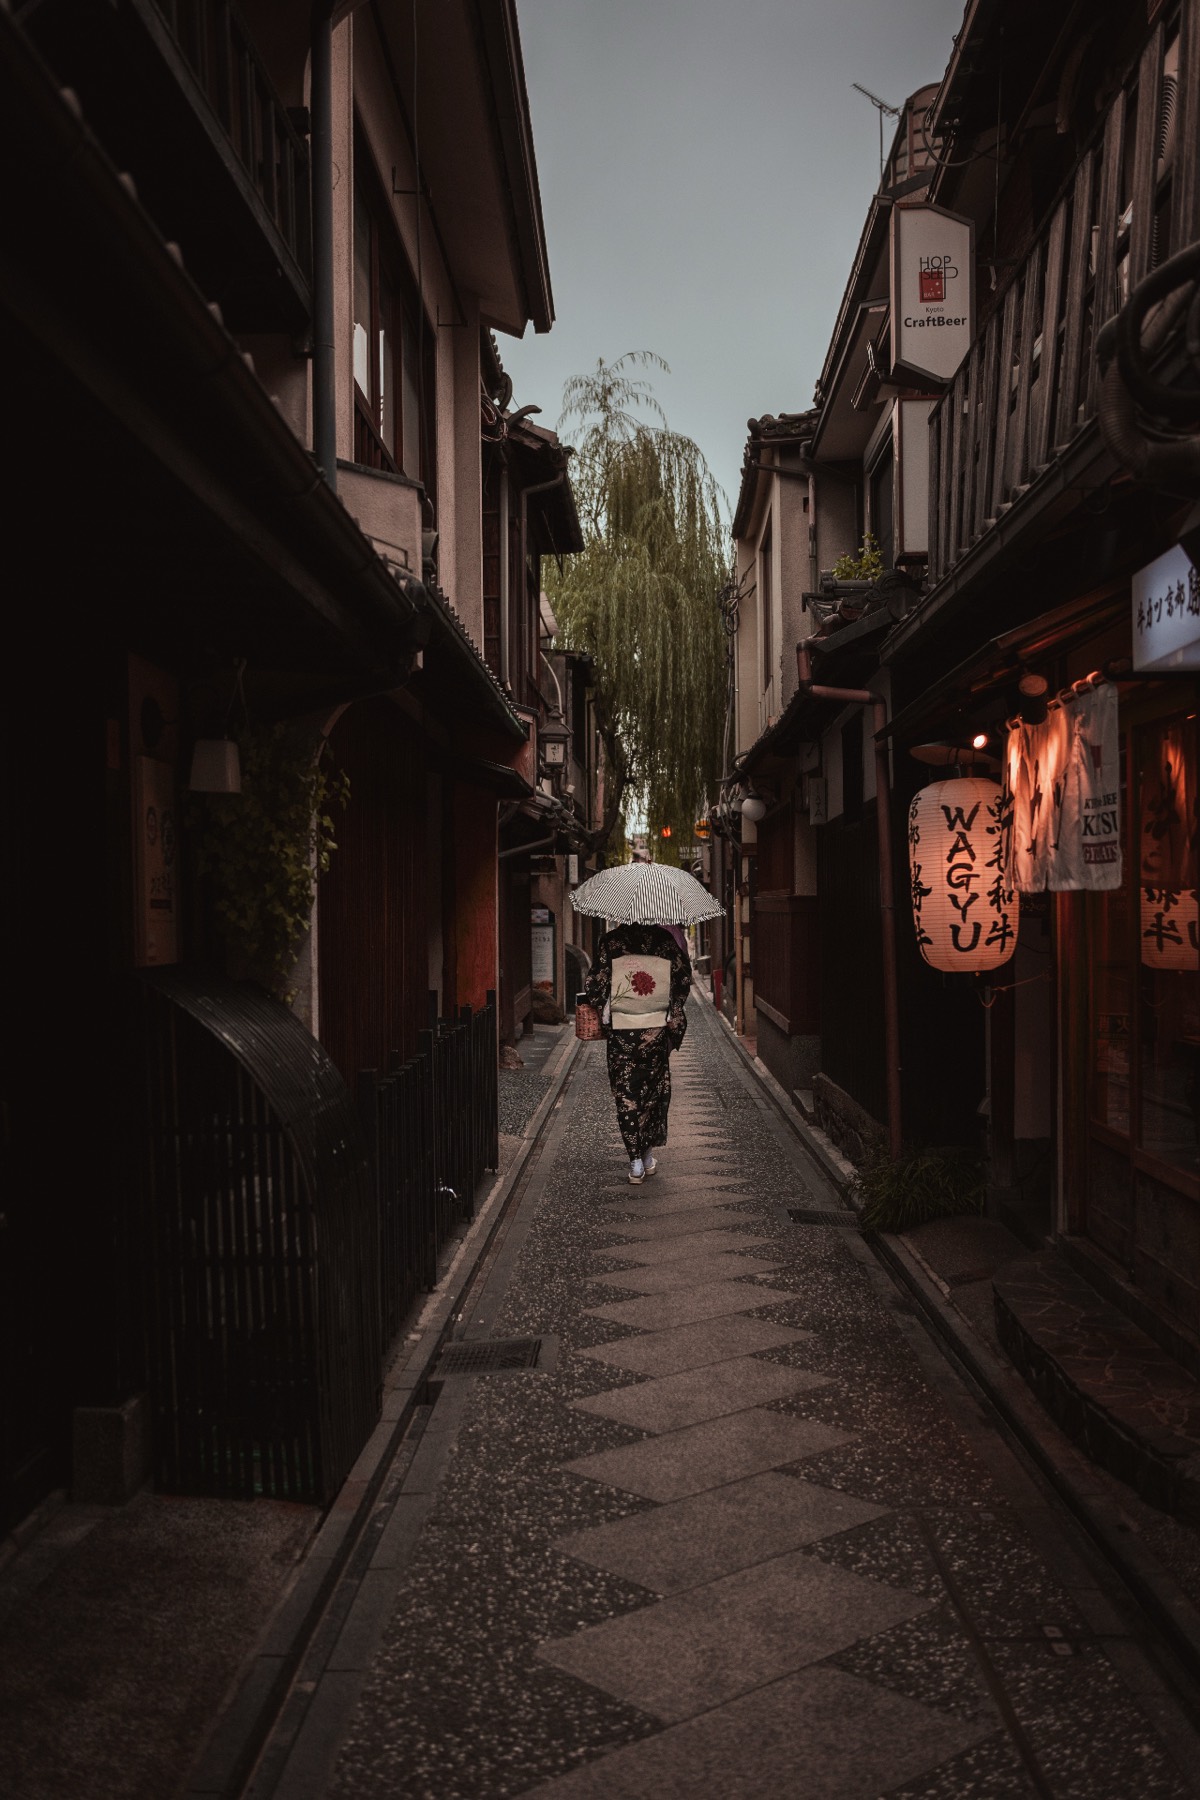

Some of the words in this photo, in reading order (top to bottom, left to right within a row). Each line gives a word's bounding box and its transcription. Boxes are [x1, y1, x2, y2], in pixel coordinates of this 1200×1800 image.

[923, 266, 959, 280] SEED
[925, 306, 944, 314] Kyoto
[904, 316, 968, 328] CraftBeer
[940, 801, 982, 953] WAGYU
